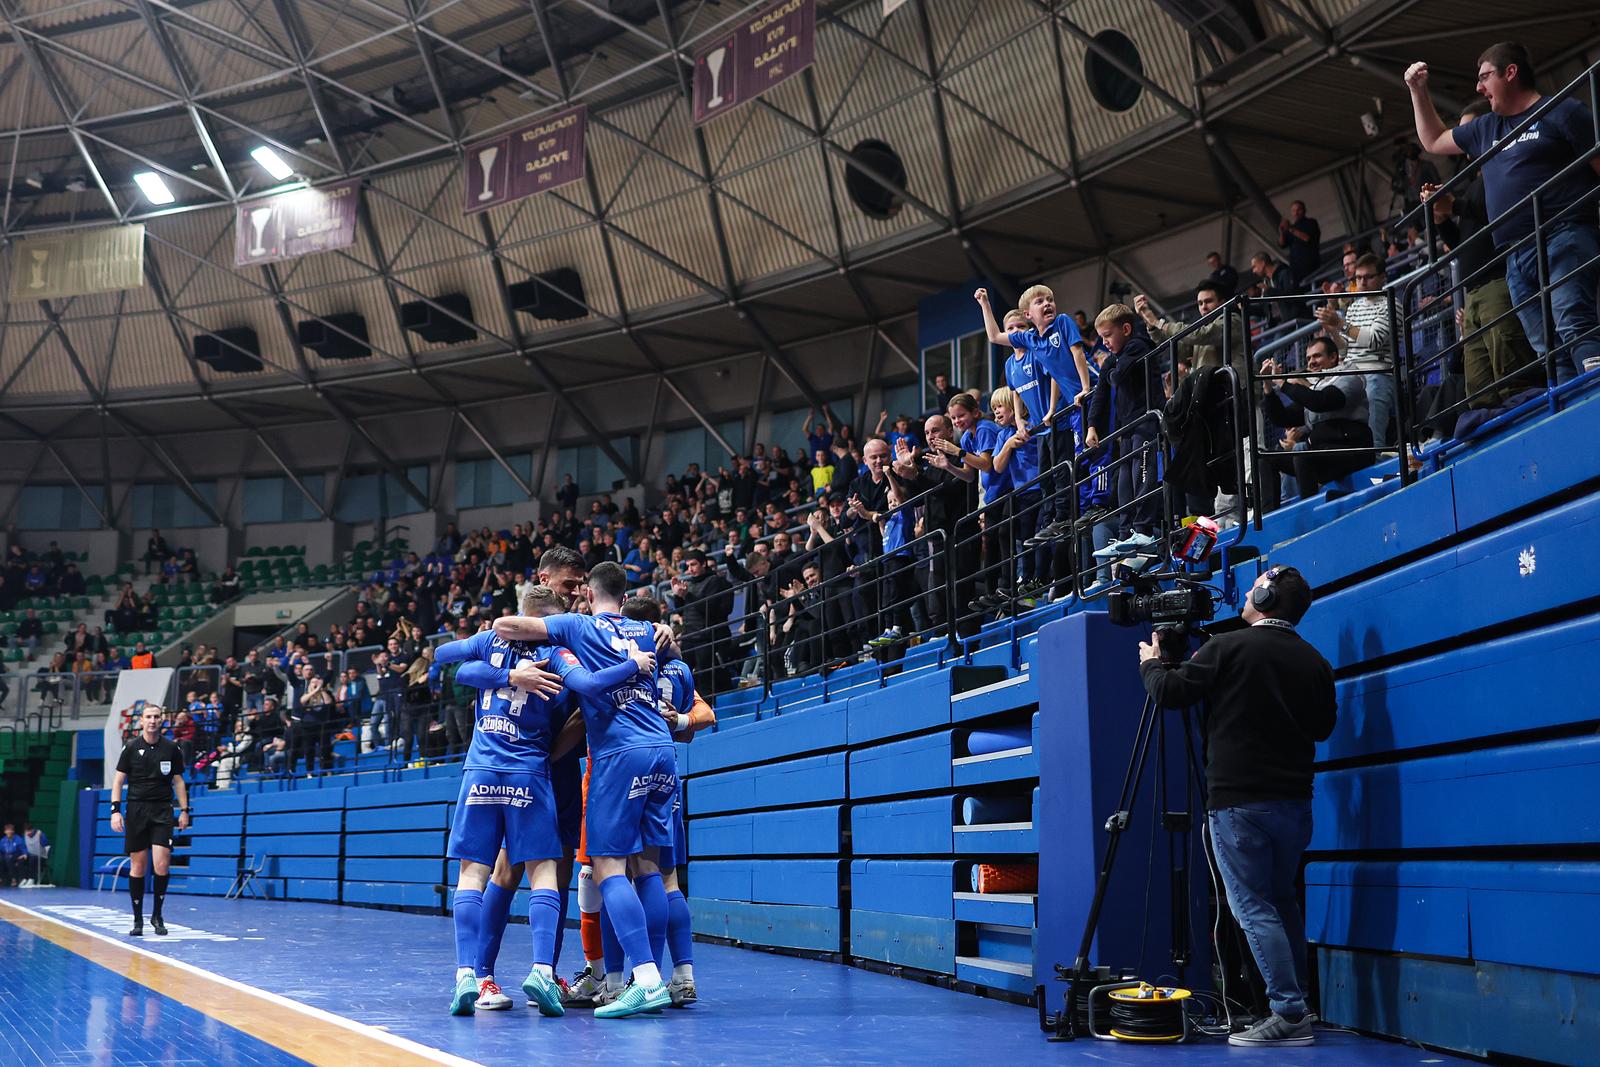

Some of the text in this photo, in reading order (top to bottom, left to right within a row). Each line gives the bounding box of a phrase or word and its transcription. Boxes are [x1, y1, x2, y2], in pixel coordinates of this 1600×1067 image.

[482, 716, 516, 735] Ožujsko
[630, 773, 676, 789] ADMIRAL
[468, 783, 534, 799] ADMIRAL
[510, 797, 533, 808] BET
